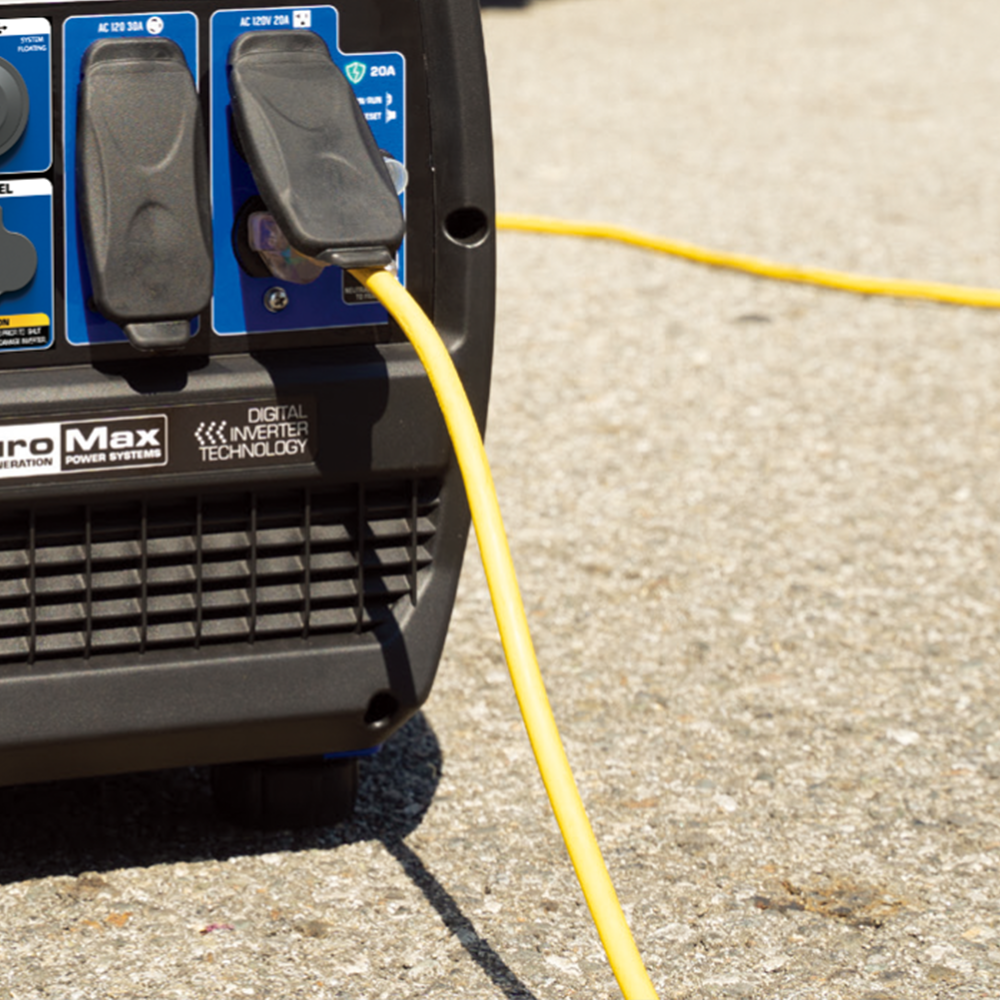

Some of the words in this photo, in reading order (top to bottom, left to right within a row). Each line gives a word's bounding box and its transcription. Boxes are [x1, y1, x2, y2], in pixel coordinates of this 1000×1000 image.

[98, 23, 109, 33] AC
[127, 21, 144, 32] 30A
[240, 16, 251, 27] AC
[252, 15, 272, 26] 120V
[273, 14, 290, 26] 20A
[370, 65, 396, 77] 20A
[364, 111, 382, 121] ESET
[248, 404, 308, 423] DIGITAL
[65, 426, 160, 453] Max
[230, 421, 308, 442] INVERTER
[65, 454, 106, 465] POWER
[109, 449, 162, 462] SYSTEMS
[199, 439, 307, 462] TECHNOLOGY
